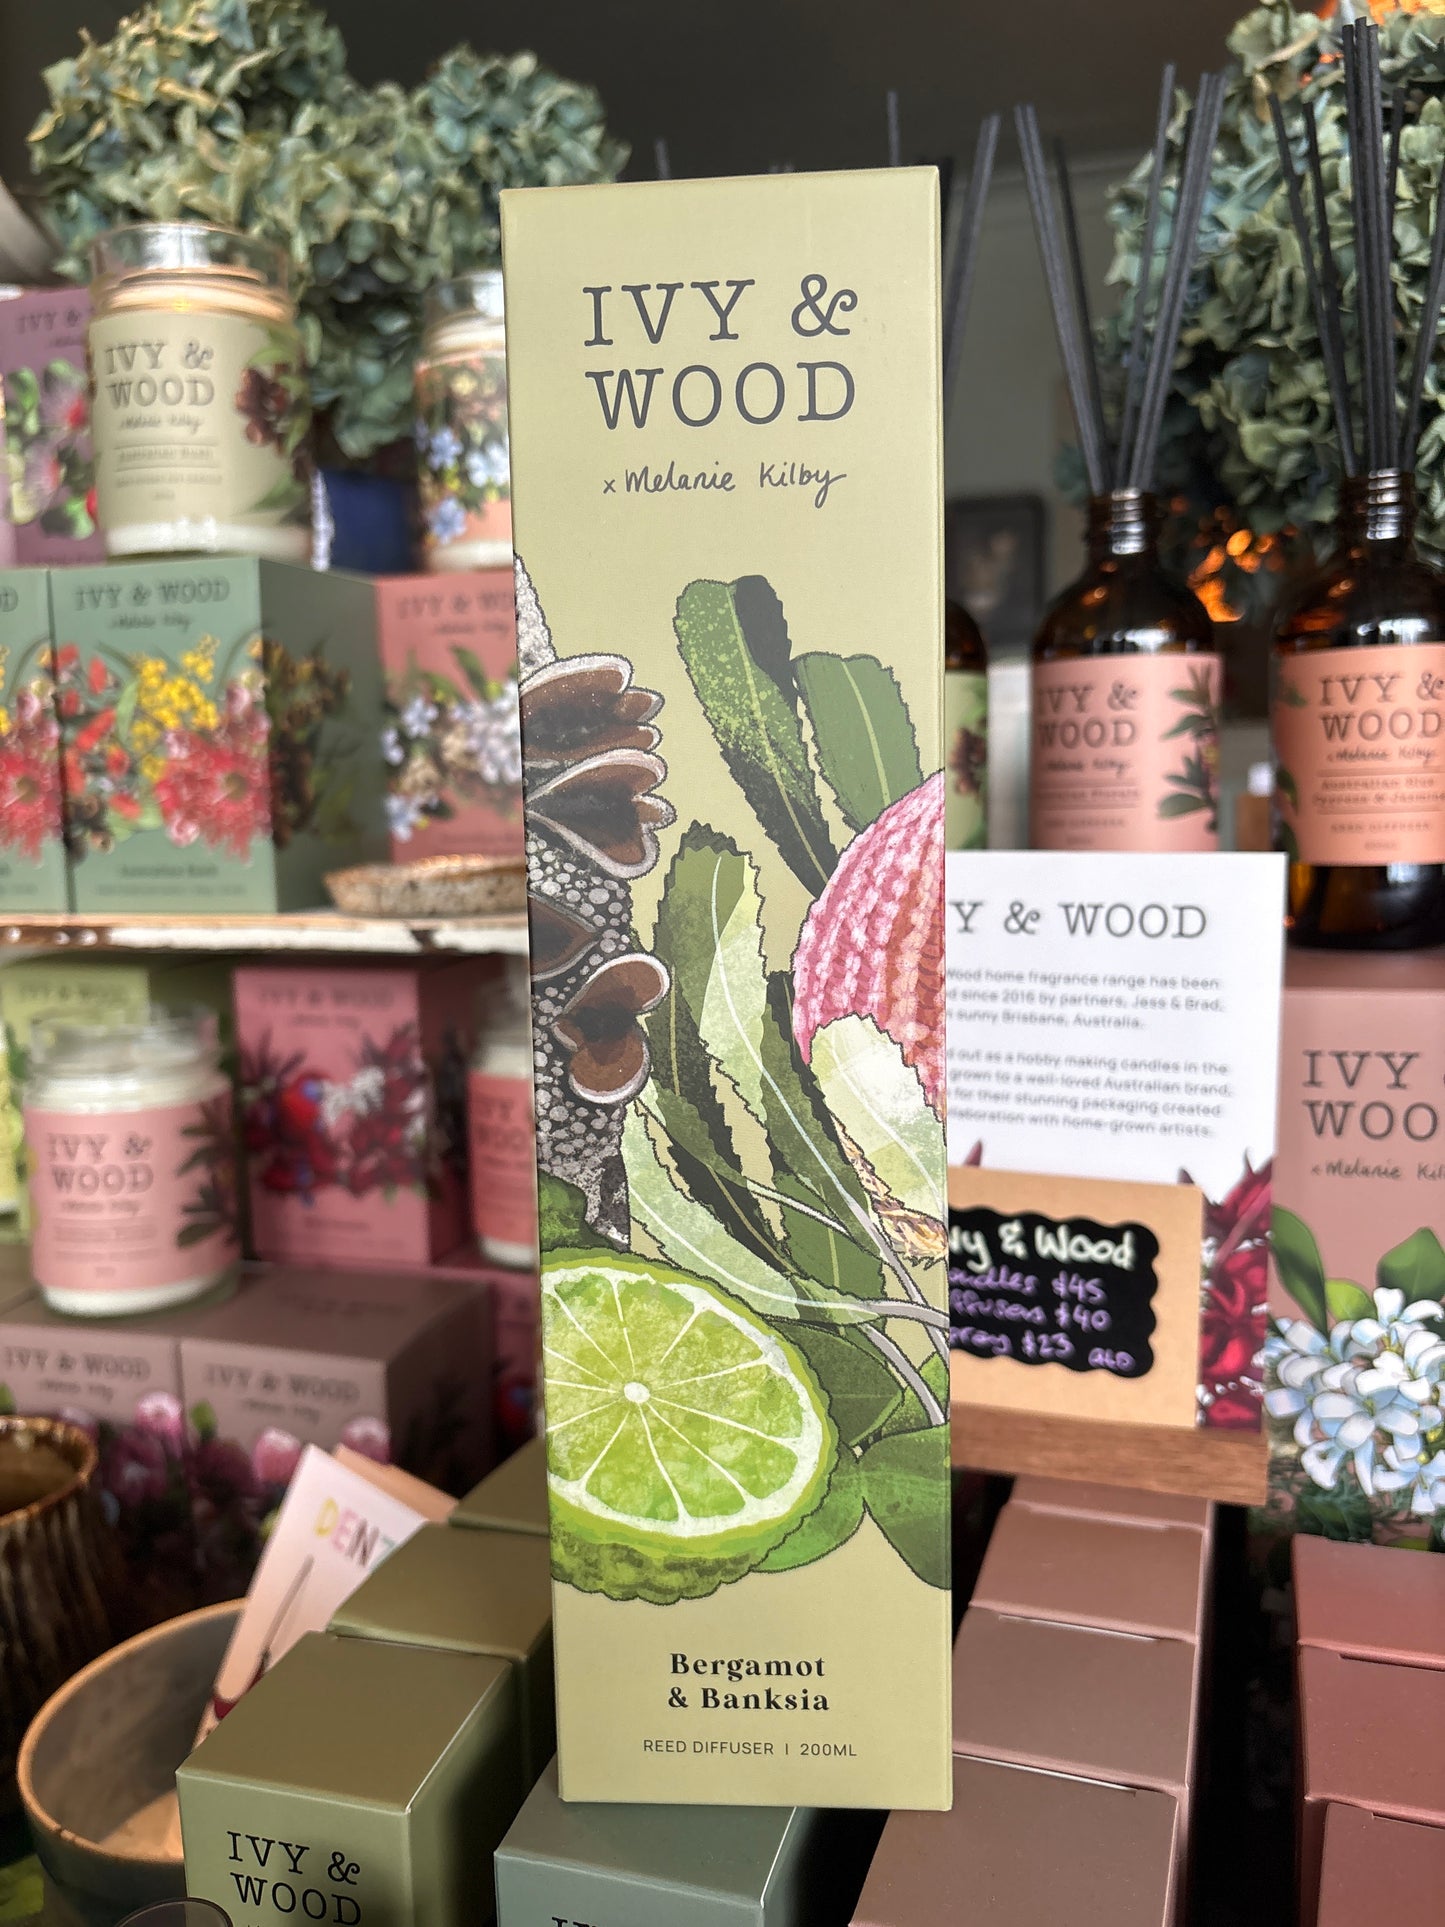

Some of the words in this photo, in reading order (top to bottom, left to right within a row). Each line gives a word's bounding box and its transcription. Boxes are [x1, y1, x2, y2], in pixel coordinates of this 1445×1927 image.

[583, 279, 755, 346] IVY
[790, 274, 859, 337] &
[104, 340, 167, 375] IVY
[183, 339, 215, 371] &
[106, 375, 216, 410] WOOD
[585, 361, 856, 430] WOOD
[625, 461, 737, 494] Melanie
[759, 462, 847, 509] Kilby
[1107, 680, 1137, 711] &
[1319, 674, 1402, 706] IVY
[1416, 672, 1445, 700] &
[1038, 717, 1138, 749] WOOD
[1319, 709, 1442, 742] WOOD
[1003, 900, 1041, 935] &
[1058, 902, 1208, 939] WOOD
[985, 969, 1024, 982] home
[1029, 971, 1098, 986] fragrance
[1103, 975, 1145, 990] range
[1150, 976, 1178, 989] has
[1181, 977, 1219, 990] been
[961, 989, 998, 1002] since
[1039, 992, 1055, 1006] by
[958, 1009, 999, 1023] sunny
[959, 1049, 982, 1061] out
[985, 1051, 1001, 1062] as
[1017, 1051, 1060, 1068] hobby
[1064, 1055, 1116, 1073] making
[1120, 1058, 1179, 1073] candles
[1183, 1060, 1198, 1074] in
[1202, 1062, 1228, 1075] the
[1301, 1050, 1420, 1089] IVY
[995, 1069, 1010, 1081] to
[1104, 1077, 1180, 1093] Australian
[1015, 1092, 1079, 1110] stunning
[1082, 1098, 1160, 1117] packaging
[1162, 1102, 1221, 1118] created
[1027, 1114, 1060, 1127] with
[1301, 1100, 1439, 1142] WOO
[48, 1132, 109, 1163] IVY
[52, 1162, 154, 1196] WOOD
[1325, 1157, 1402, 1179] Melanie
[998, 1219, 1029, 1262] &
[1034, 1223, 1136, 1272] Wood
[1051, 1269, 1107, 1305] $45
[1054, 1301, 1113, 1333] $40
[669, 1652, 826, 1682] Bergamot
[668, 1686, 689, 1709] &
[701, 1687, 830, 1711] Banksia
[643, 1739, 687, 1753] REED
[693, 1740, 774, 1755] DIFFUSER
[800, 1743, 857, 1757] 200ML
[227, 1830, 310, 1875] IVY
[327, 1850, 361, 1886] &
[230, 1871, 362, 1926] WOOD
